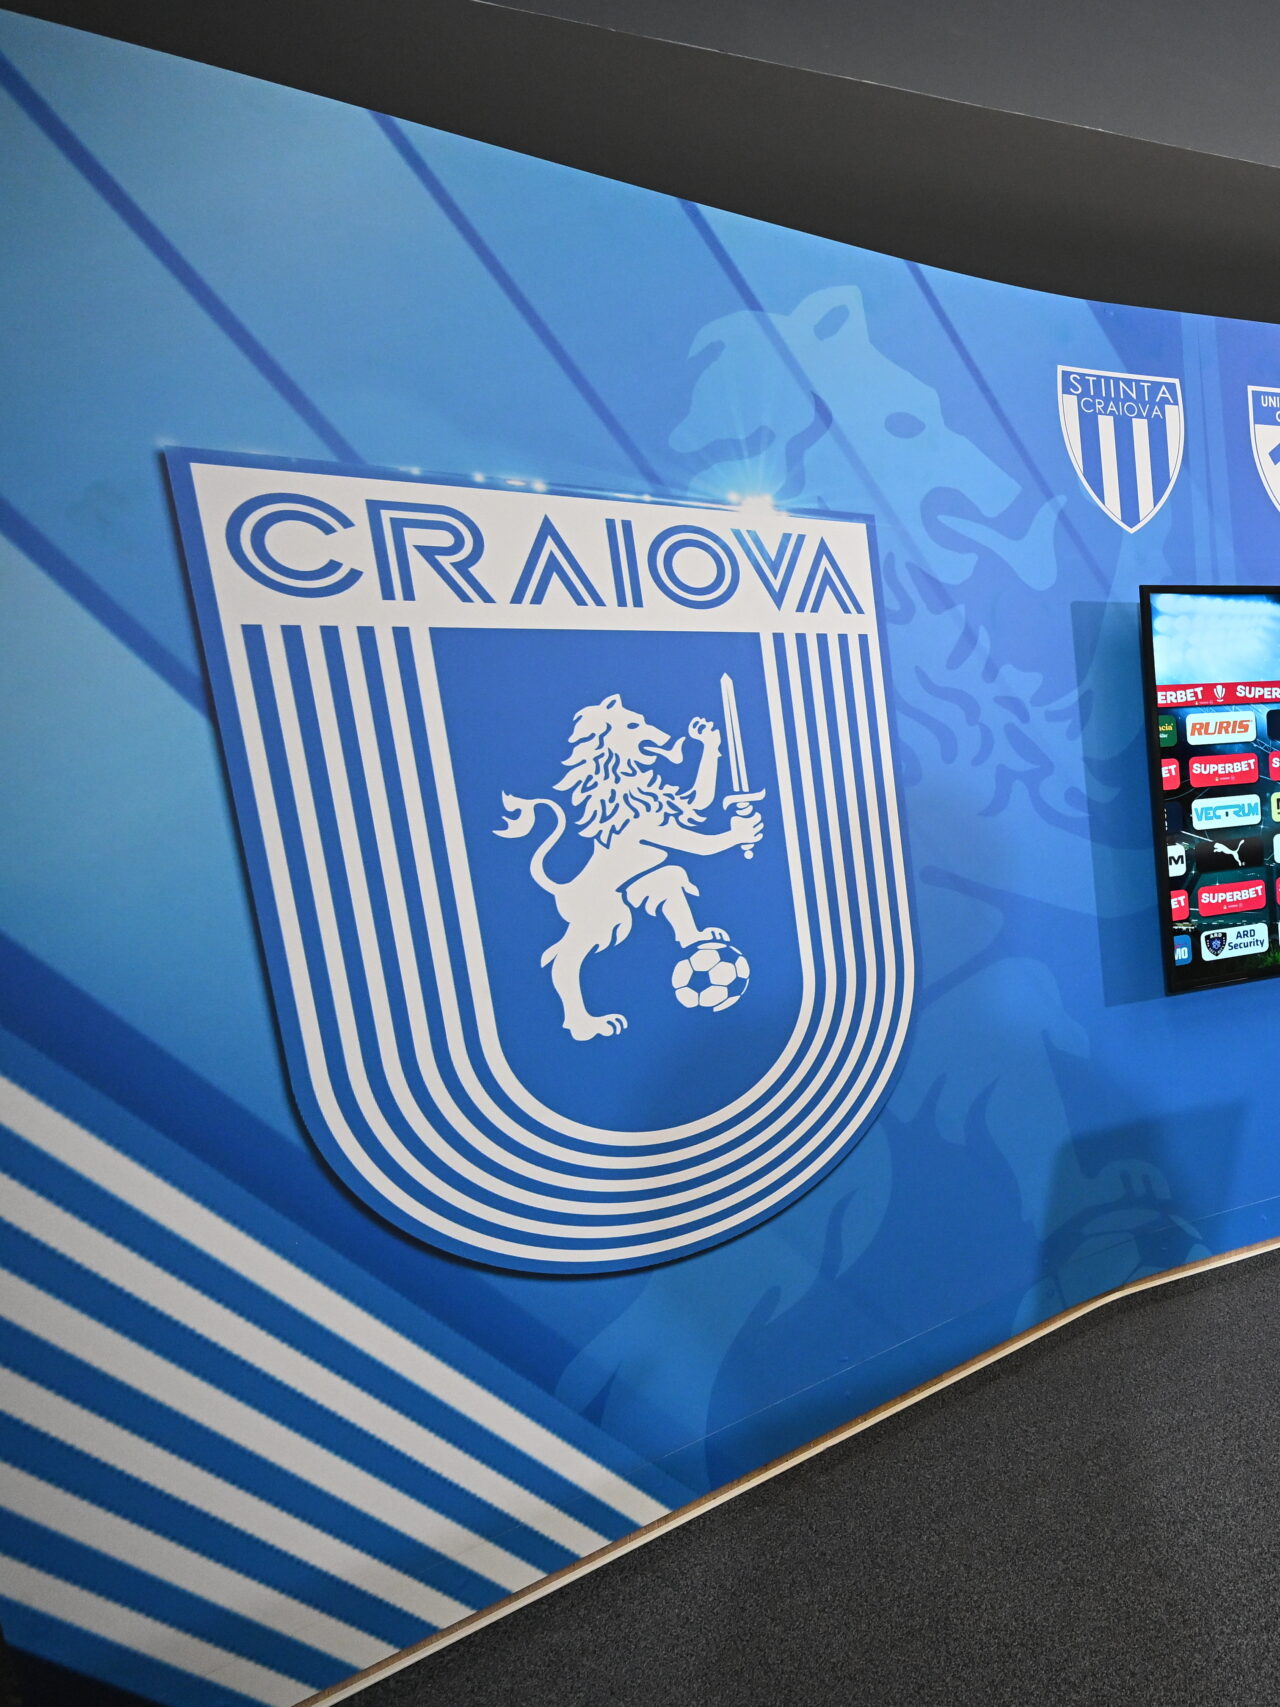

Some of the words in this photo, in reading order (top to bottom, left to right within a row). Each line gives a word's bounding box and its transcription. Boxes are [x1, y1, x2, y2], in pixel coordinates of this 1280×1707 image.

[1069, 374, 1174, 404] STIINTA
[1080, 397, 1163, 420] CRAIOVA
[225, 492, 865, 615] CRAIOVA
[1190, 719, 1251, 736] RURIS
[1193, 760, 1256, 775] SUPERBET
[1194, 802, 1259, 822] VECTRUM
[1201, 886, 1263, 903] SUPERBET
[1236, 929, 1255, 939] ARD
[1228, 937, 1265, 951] Security
